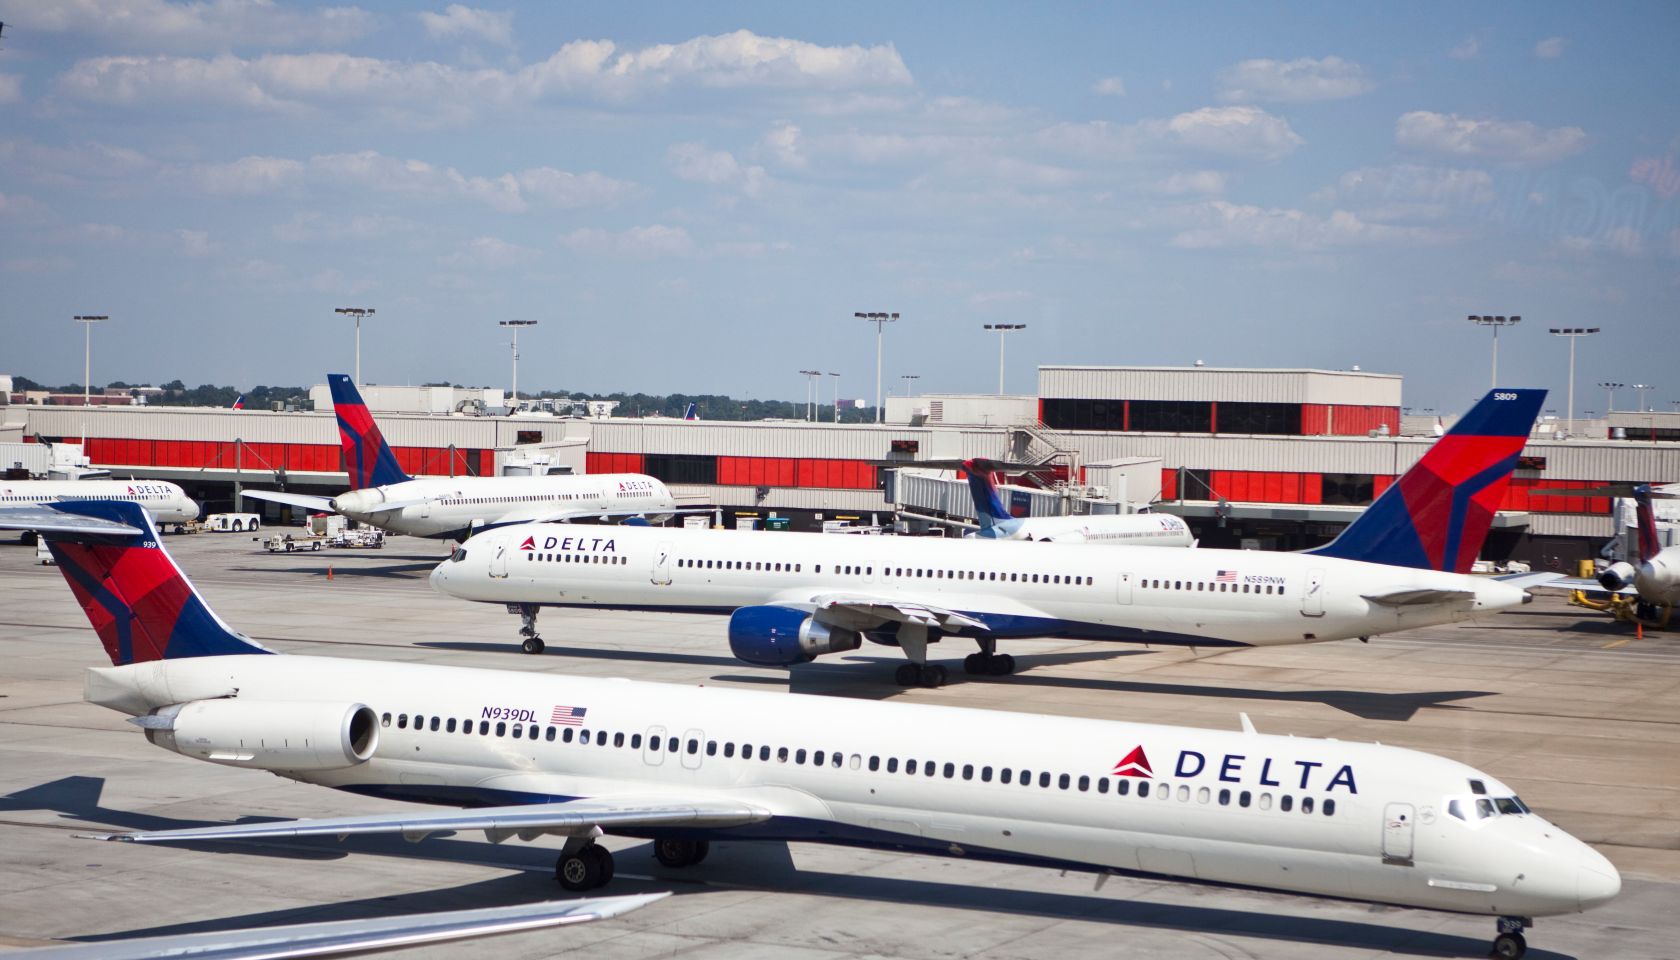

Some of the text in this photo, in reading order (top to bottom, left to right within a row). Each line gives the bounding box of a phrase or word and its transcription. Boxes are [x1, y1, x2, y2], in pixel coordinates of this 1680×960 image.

[1494, 392, 1517, 401] 5809
[136, 485, 172, 494] DELTA
[626, 481, 654, 490] DELTA
[143, 541, 157, 549] 939
[544, 536, 616, 552] DELTA
[481, 706, 538, 723] N939DL
[1174, 750, 1359, 795] DELTA
